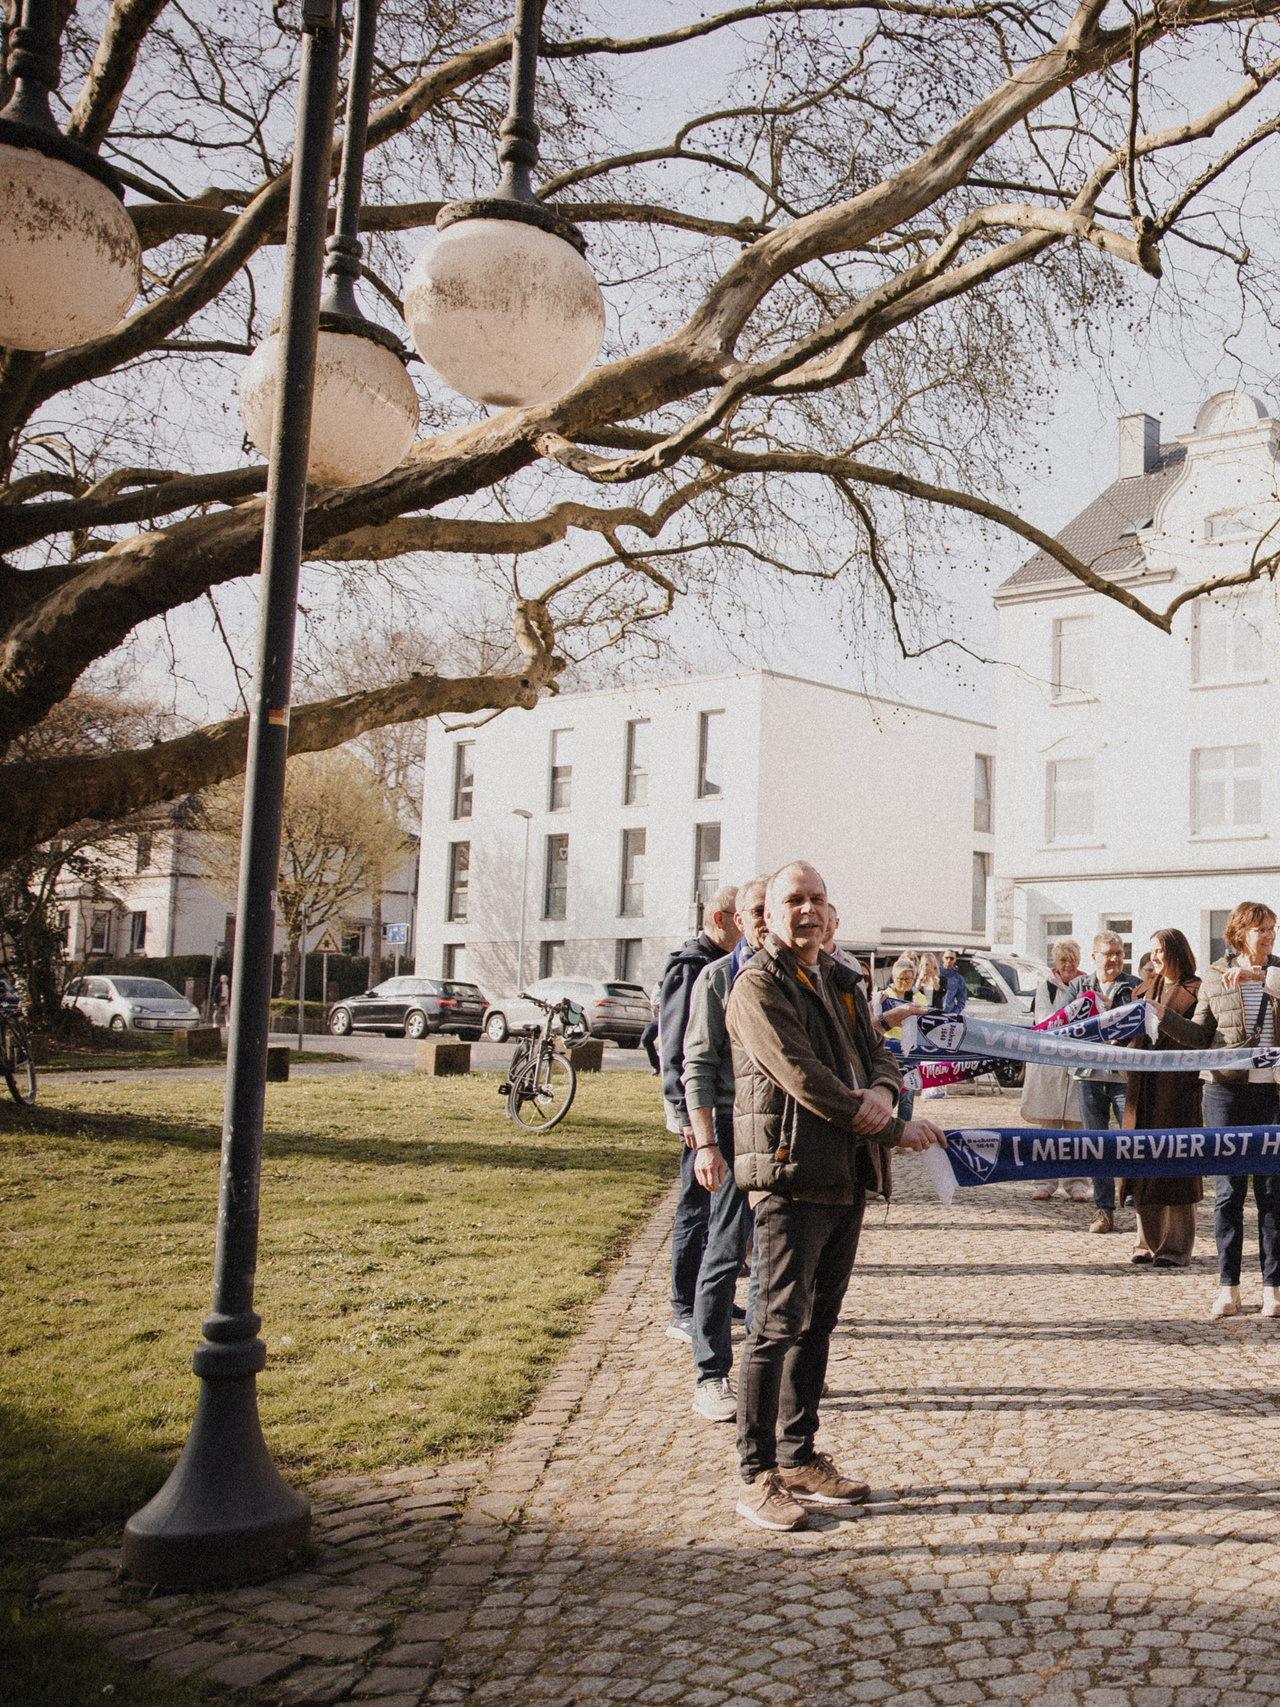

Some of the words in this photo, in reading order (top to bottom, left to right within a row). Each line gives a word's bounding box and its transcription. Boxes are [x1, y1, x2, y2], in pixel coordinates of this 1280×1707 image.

[980, 1026, 1033, 1053] VfL
[1039, 1039, 1163, 1066] Bochum
[1171, 1049, 1239, 1066] 1848
[922, 1062, 950, 1079] Mein
[948, 1139, 989, 1173] VfL
[1032, 1137, 1104, 1161] MEIN
[1115, 1134, 1206, 1160] REVIER
[1213, 1132, 1253, 1157] IST
